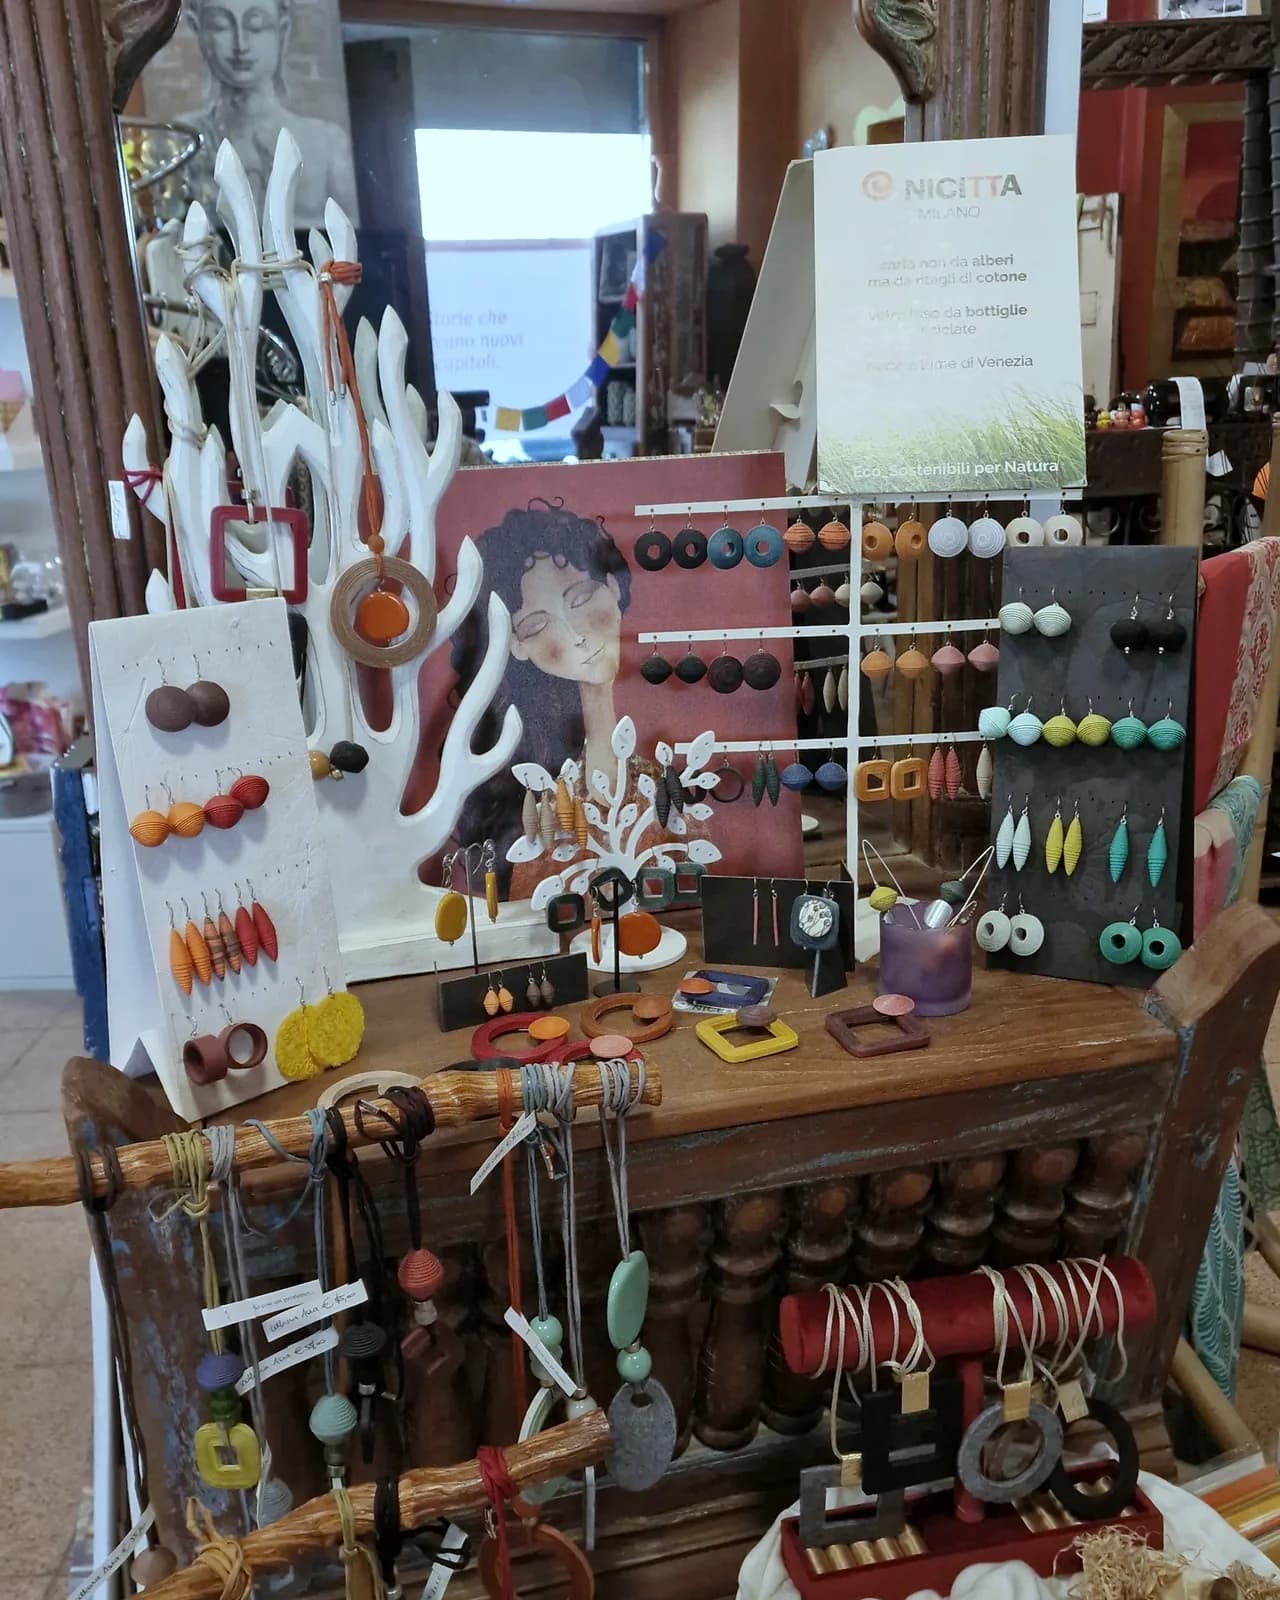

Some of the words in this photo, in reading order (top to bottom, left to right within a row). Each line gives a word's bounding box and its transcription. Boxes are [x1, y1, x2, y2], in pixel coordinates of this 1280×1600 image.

[917, 205, 981, 220] MILANO
[919, 258, 946, 270] non
[950, 255, 968, 267] da
[972, 252, 1014, 266] alberi
[868, 278, 890, 289] ma
[959, 271, 972, 285] di
[976, 271, 1028, 285] cotone
[944, 307, 962, 319] da
[965, 303, 1028, 319] bottiglie
[961, 356, 974, 369] di
[977, 354, 1033, 368] Venezia
[853, 461, 970, 478] Eco_Sostenibili
[974, 463, 1001, 477] per
[1004, 460, 1060, 474] Natura
